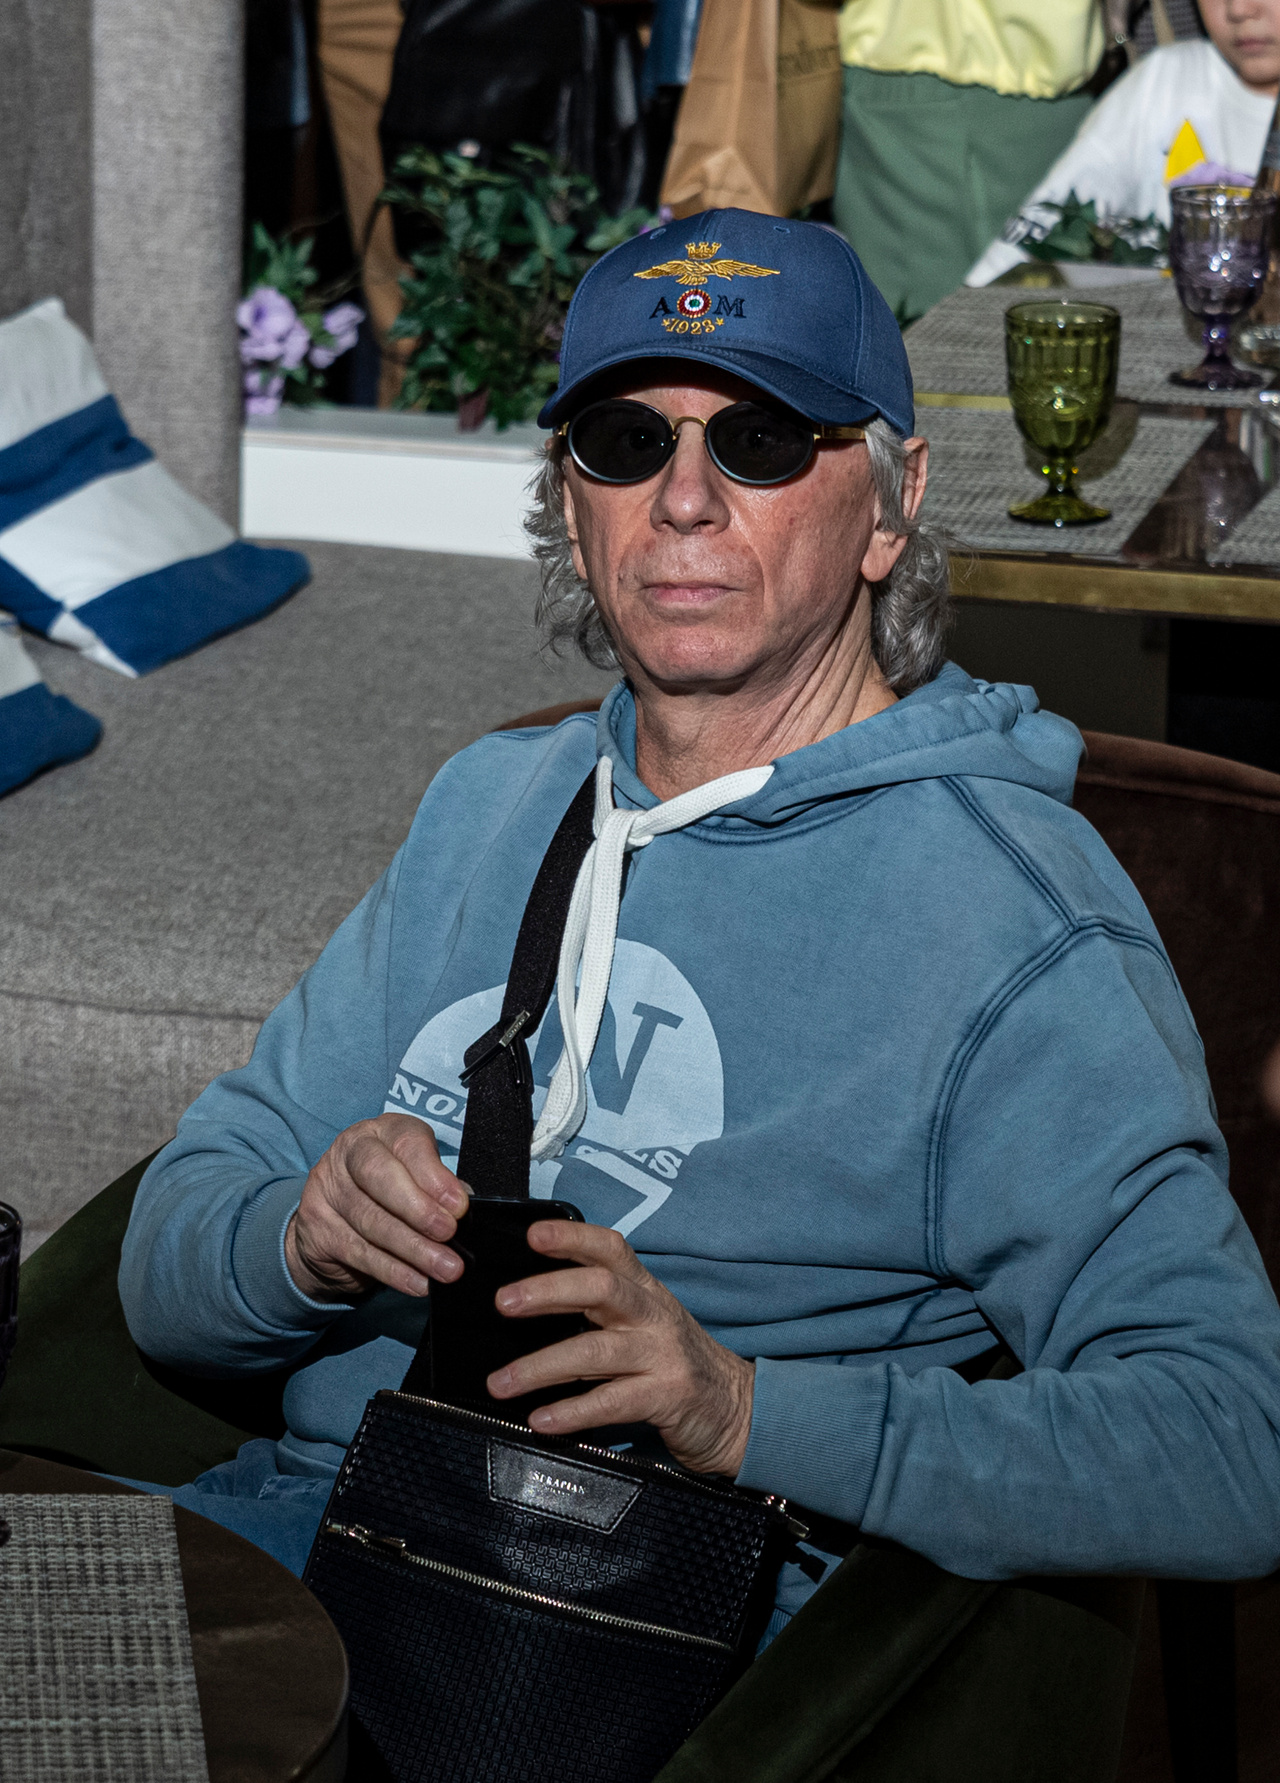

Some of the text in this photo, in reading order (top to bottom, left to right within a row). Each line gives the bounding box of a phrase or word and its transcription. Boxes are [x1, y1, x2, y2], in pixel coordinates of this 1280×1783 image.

[649, 294, 747, 319] A M
[667, 318, 717, 335] 1923
